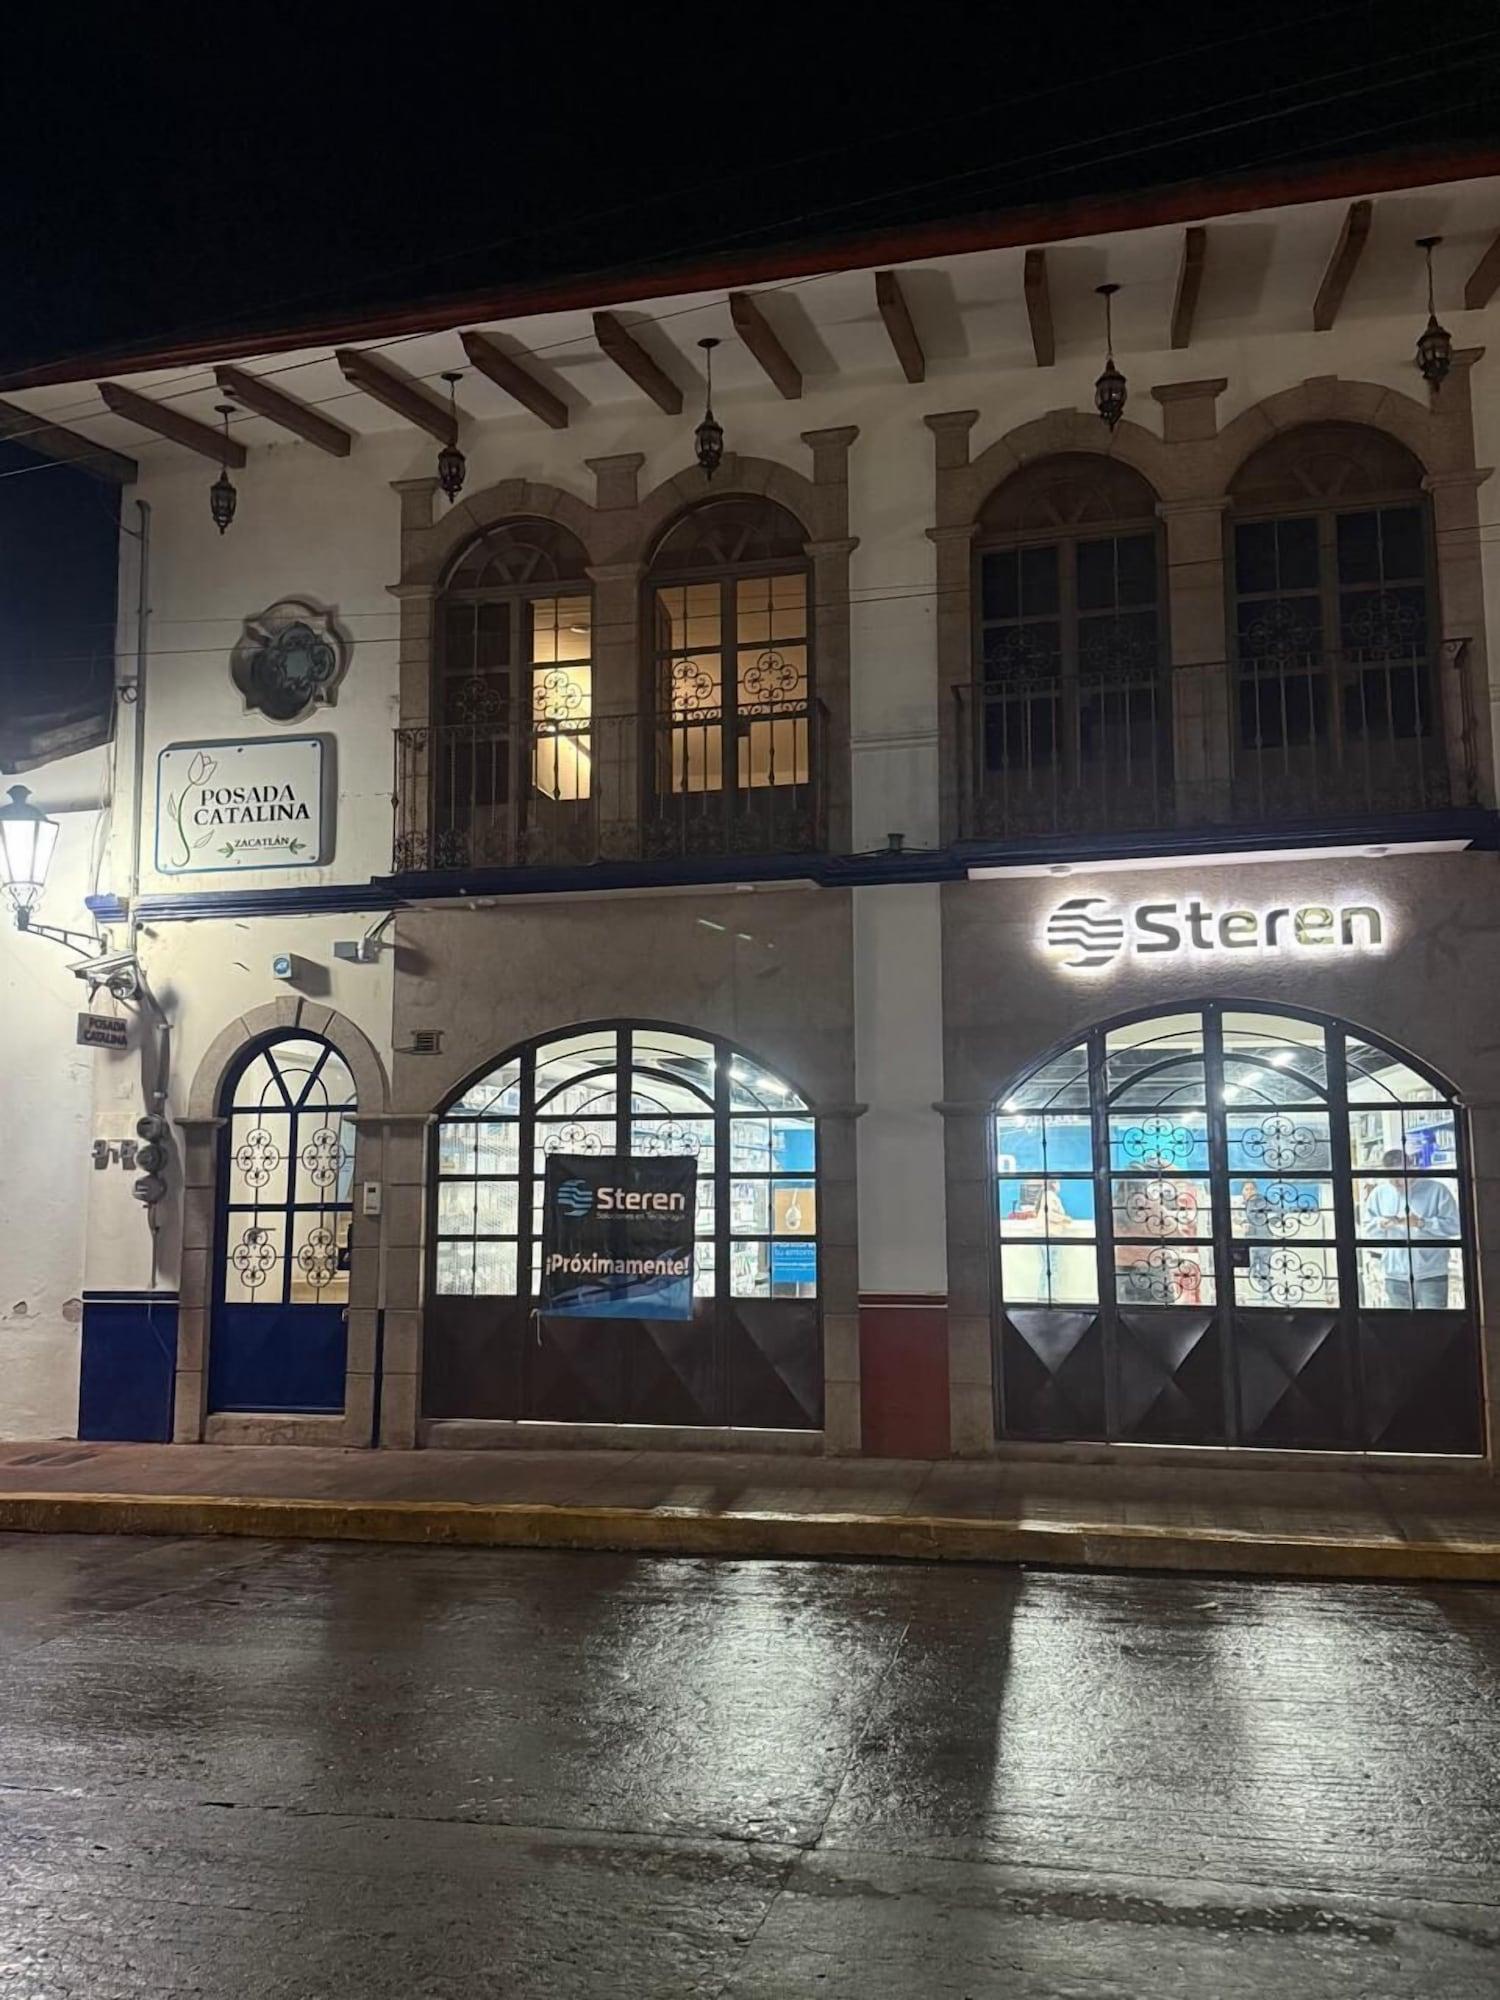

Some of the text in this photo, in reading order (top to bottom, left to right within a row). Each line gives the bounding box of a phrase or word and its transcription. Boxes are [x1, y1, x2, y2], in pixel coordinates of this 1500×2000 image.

[201, 784, 295, 806] POSADA
[194, 803, 311, 826] CATALINA
[235, 835, 290, 848] ZACATLÁN
[1135, 902, 1382, 953] Steren
[89, 1016, 126, 1032] POSADA
[597, 1187, 686, 1211] Steren
[545, 1253, 691, 1276] ¡Próximamente!
